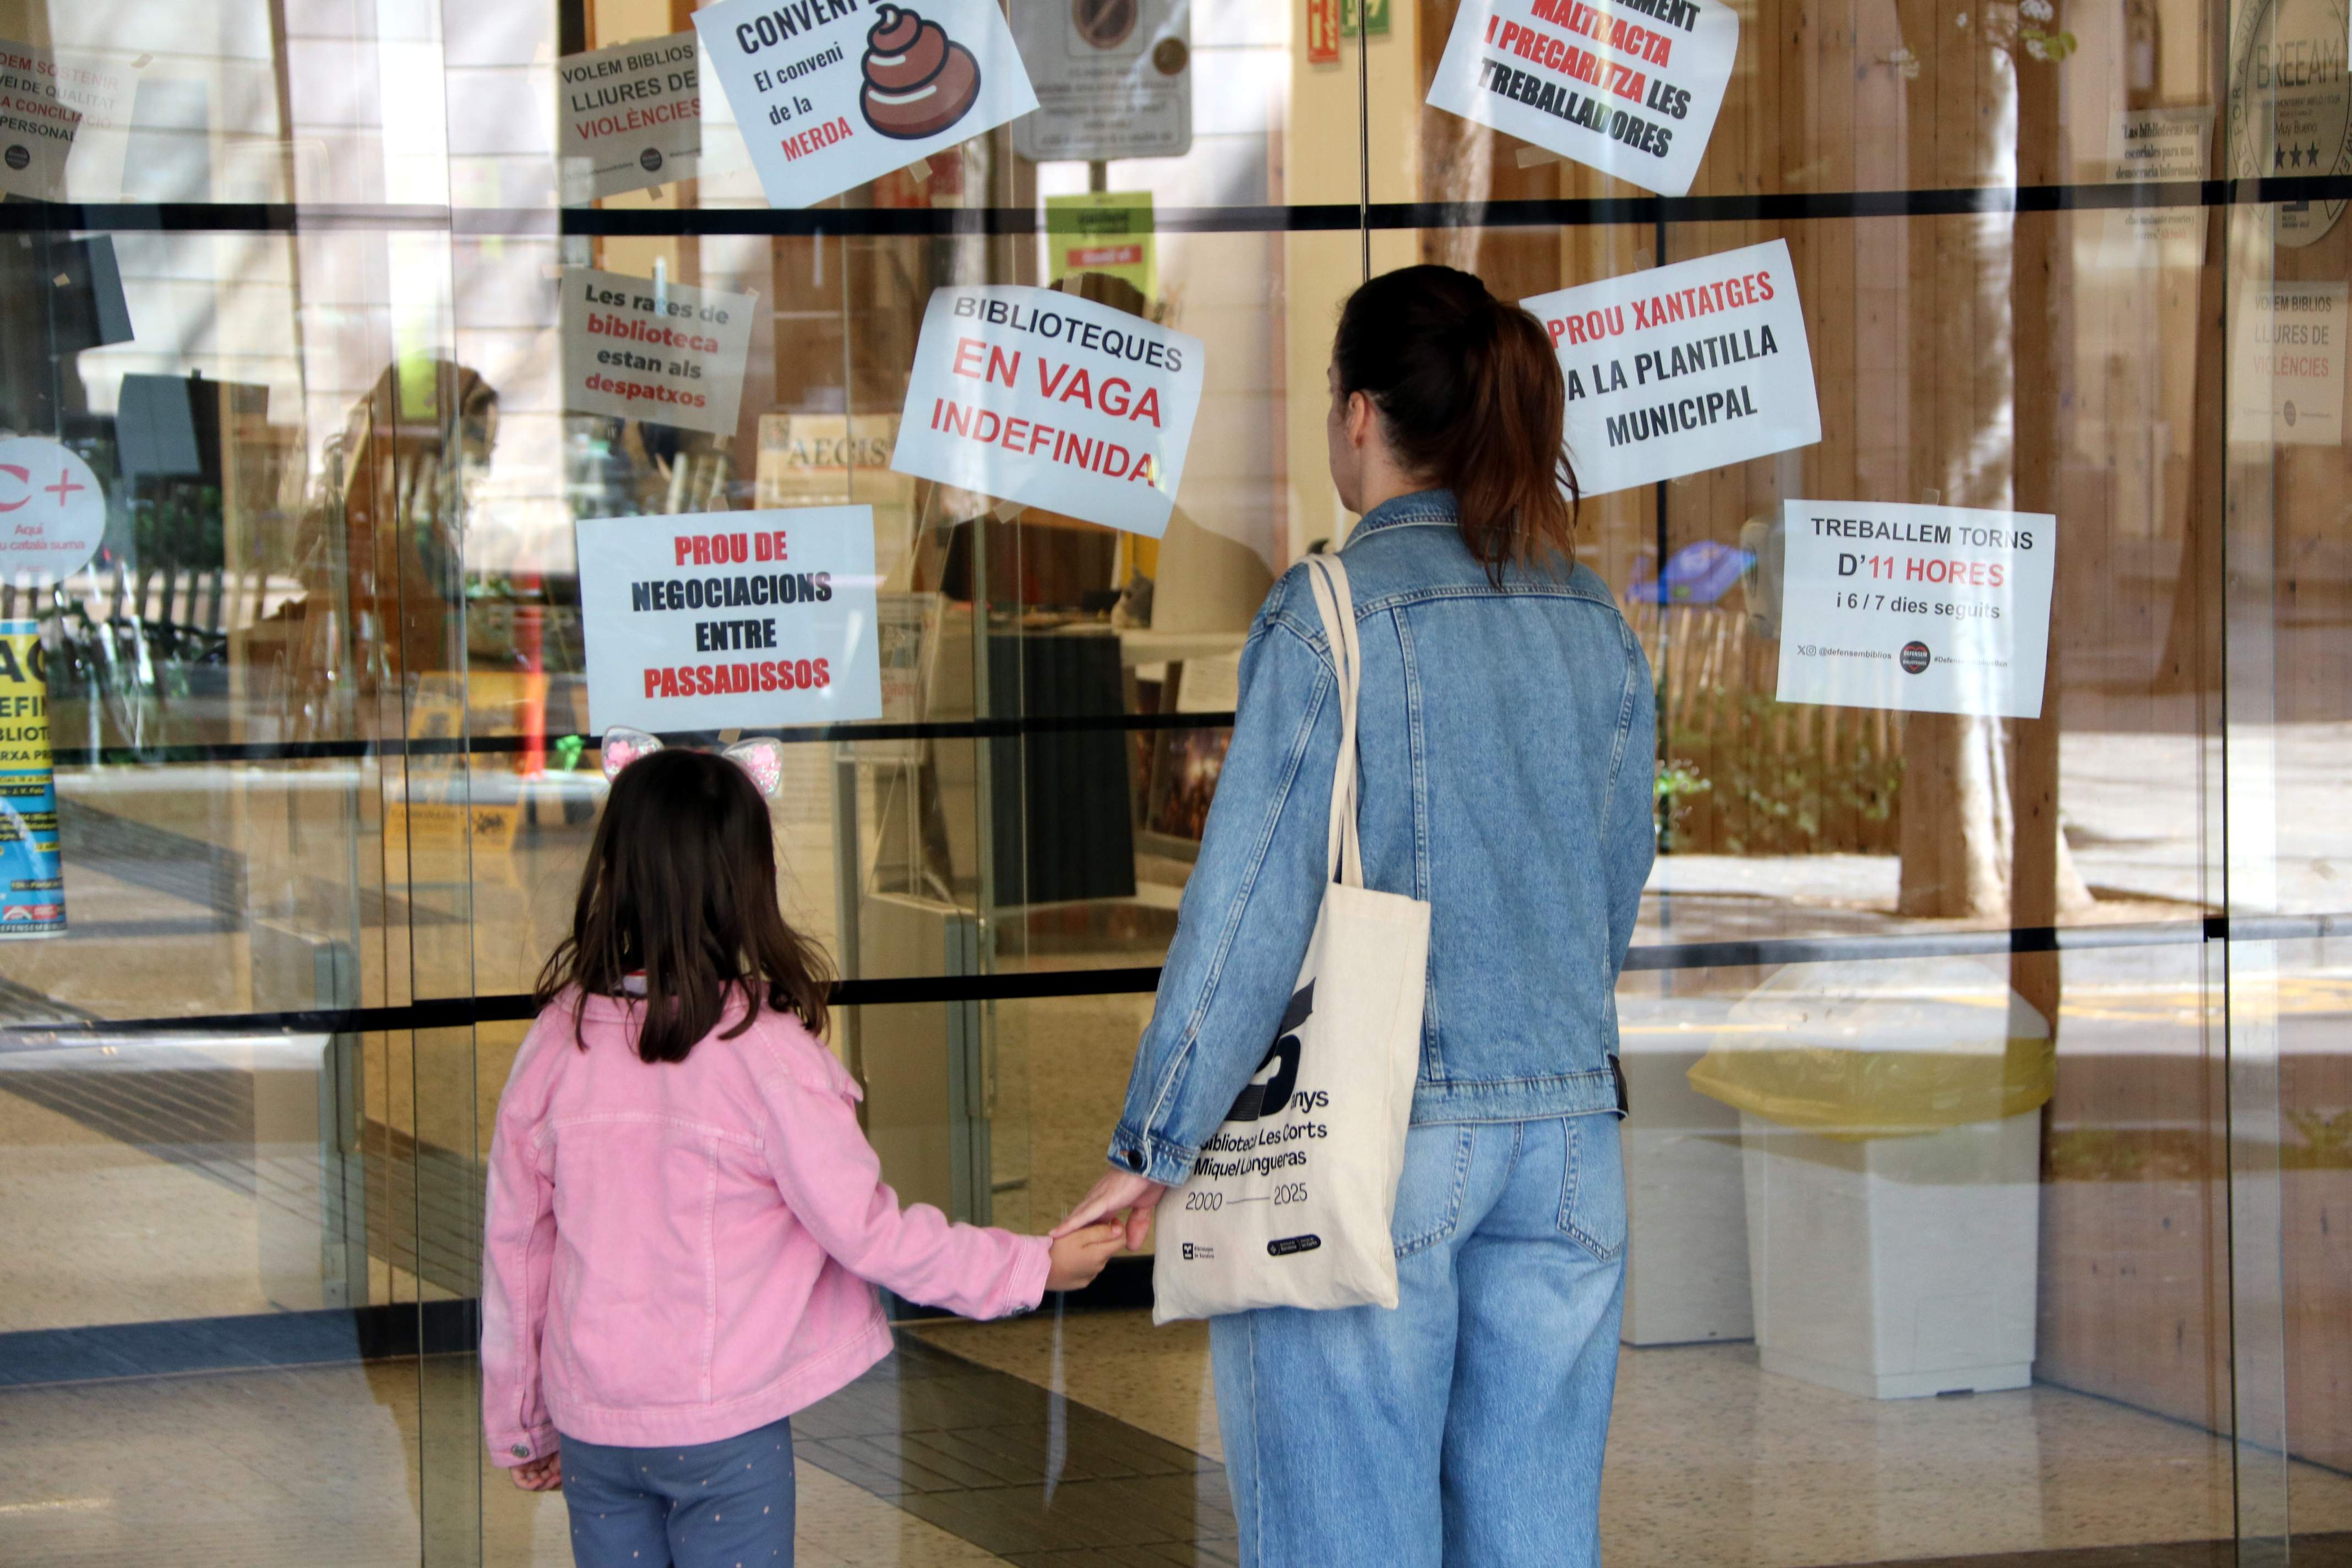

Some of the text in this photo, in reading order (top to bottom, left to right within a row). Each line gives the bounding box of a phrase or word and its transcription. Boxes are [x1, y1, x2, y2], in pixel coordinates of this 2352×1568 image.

[1531, 0, 1672, 68] MALTRACTA
[36, 61, 118, 90] SOSTENIR
[562, 45, 694, 84] VOLEM BIBLIOS
[754, 41, 843, 92] El conveni
[1484, 15, 1691, 119] I PRECARITZA LES
[2257, 37, 2338, 89] BREEAM
[21, 79, 40, 94] DE
[46, 85, 115, 109] QUALITAT
[572, 70, 698, 112] LLIURES DE
[1477, 58, 1673, 157] TREBALLADORES
[576, 98, 700, 139] VIOLÈNCIES
[769, 96, 813, 126] de la
[2295, 120, 2317, 134] Bueno
[781, 116, 853, 161] MERDA
[585, 284, 625, 307] Les
[699, 304, 729, 325] de
[1547, 271, 1774, 349] PROU XANTATGES
[2291, 296, 2332, 312] BIBLIOS
[587, 314, 718, 353] biblioteca
[954, 297, 1183, 372] BIBLIOTEQUES
[2312, 324, 2329, 345] DE
[597, 348, 701, 379] estan als
[1568, 324, 1778, 401] A LA PLANTILLA
[585, 373, 706, 409] despatxos
[952, 337, 1161, 428] EN VAGA
[1606, 385, 1758, 448] MUNICIPAL
[930, 398, 1155, 487] INDEFINIDA
[10, 537, 47, 549] català
[51, 541, 85, 549] suma
[15, 522, 43, 536] Aquí
[1811, 518, 2033, 549] TREBALLEM TORNS
[674, 531, 787, 566] PROU DE
[1905, 557, 2005, 587] HORES
[631, 571, 832, 612] NEGOCIACIONS
[1837, 592, 1841, 608] i
[1847, 593, 1858, 609] 6
[1875, 595, 1885, 610] 7
[1891, 596, 1928, 613] dies
[1934, 602, 2000, 620] seguits
[695, 618, 777, 652] ENTRE
[1819, 646, 1892, 660] @defensembiblios
[644, 658, 830, 698] PASSADISSOS
[1290, 1090, 1329, 1114] anys
[1259, 1129, 1281, 1145] Les
[1283, 1121, 1327, 1141] Corts
[1194, 1157, 1239, 1181] Miquel
[1185, 1182, 1308, 1211] 2000 2025
